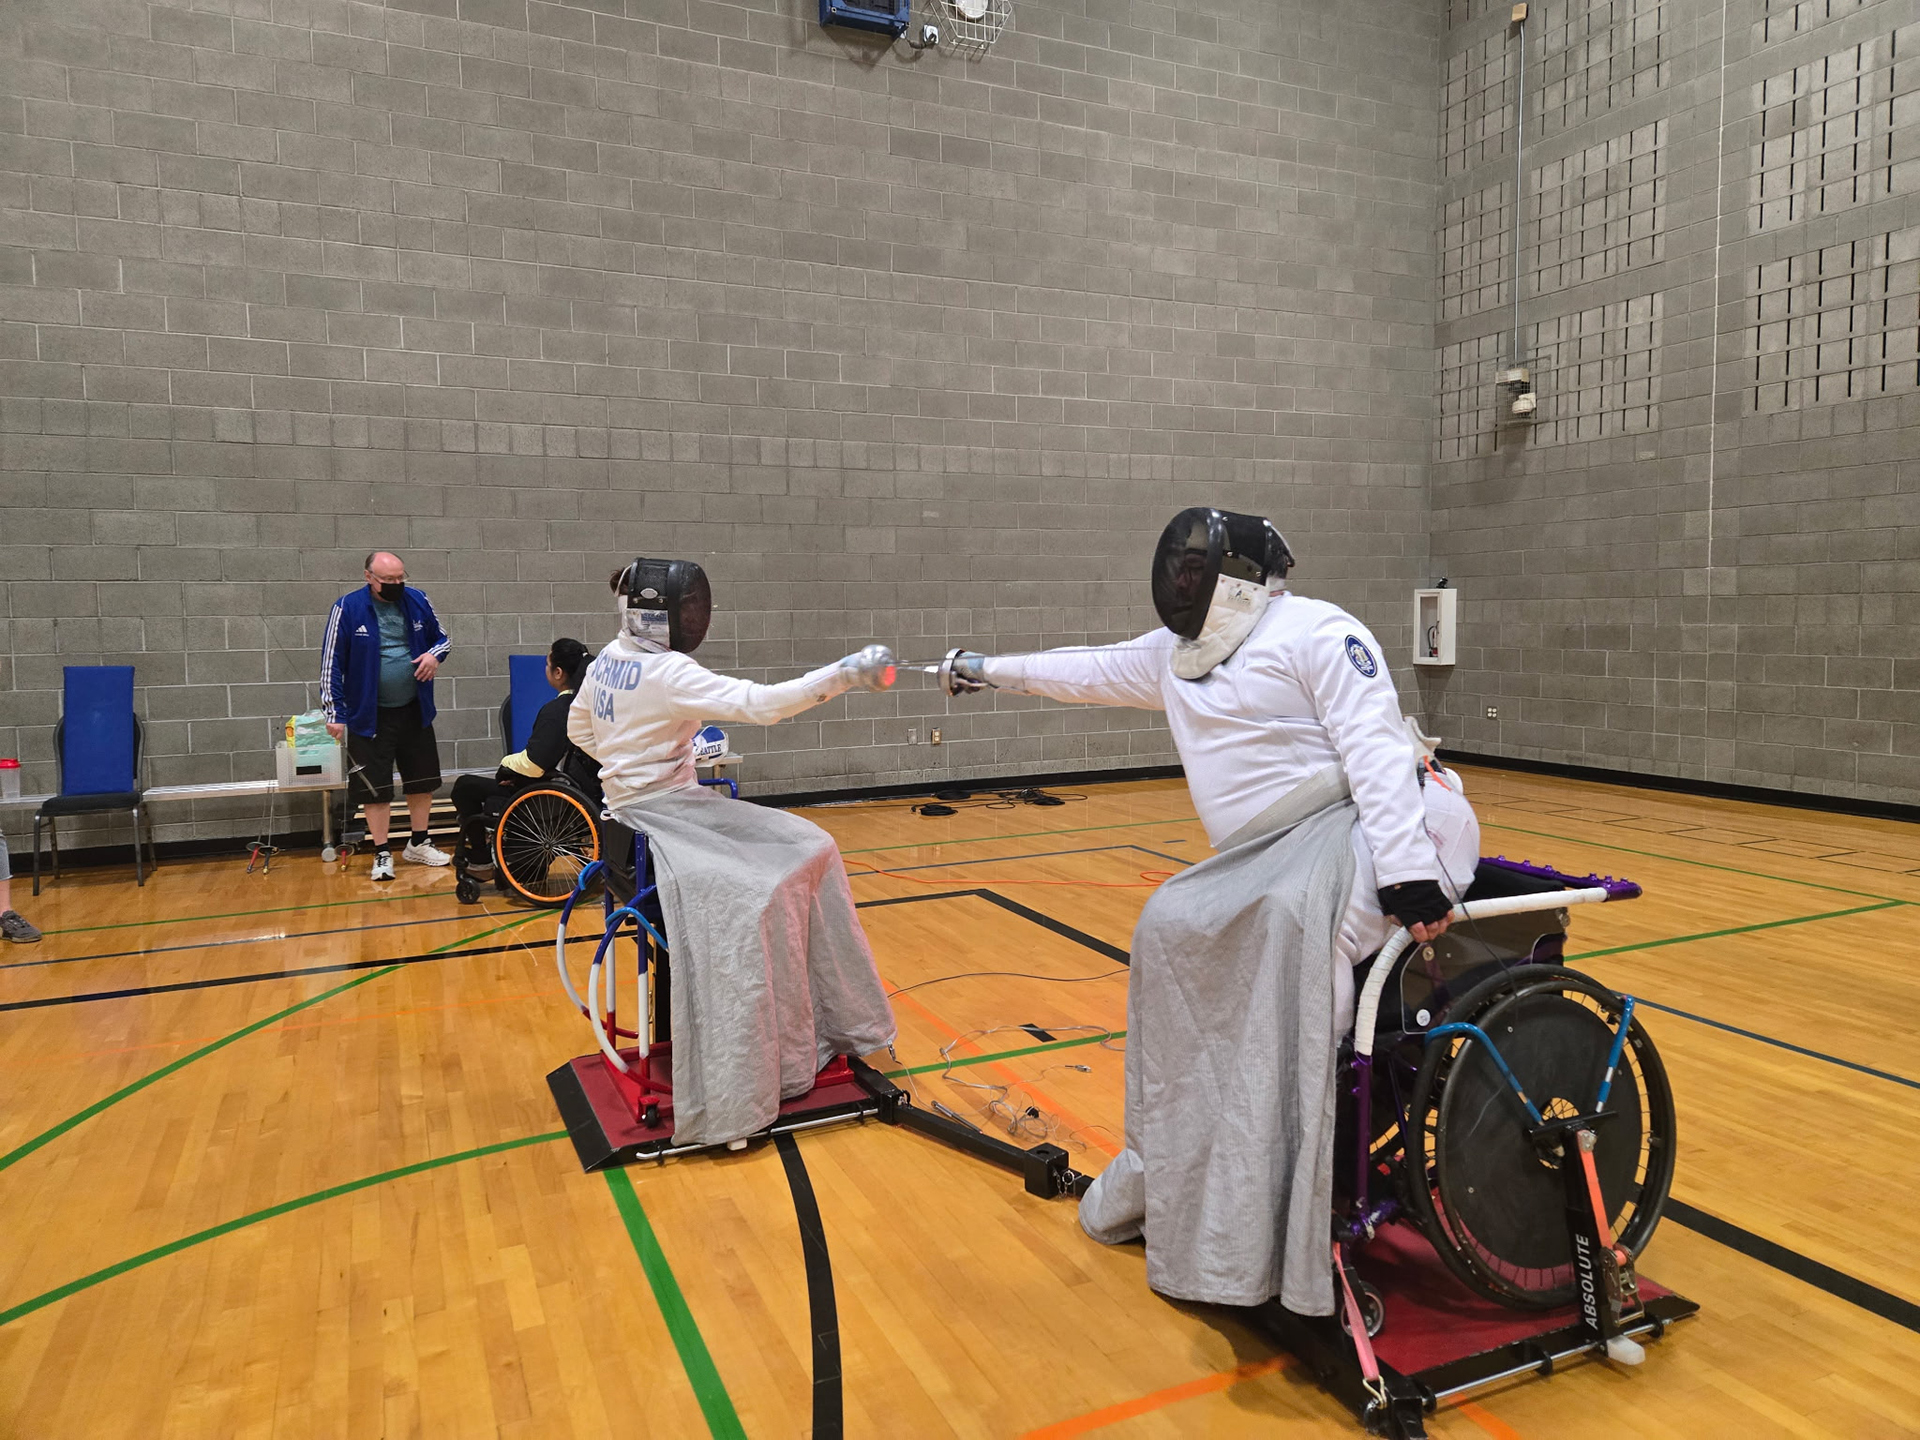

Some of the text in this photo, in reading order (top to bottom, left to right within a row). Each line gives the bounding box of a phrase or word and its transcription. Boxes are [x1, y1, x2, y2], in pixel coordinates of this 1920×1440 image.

[591, 650, 642, 690] SCHMID
[593, 686, 614, 722] USA
[1575, 1233, 1599, 1330] ABSOLUTE
